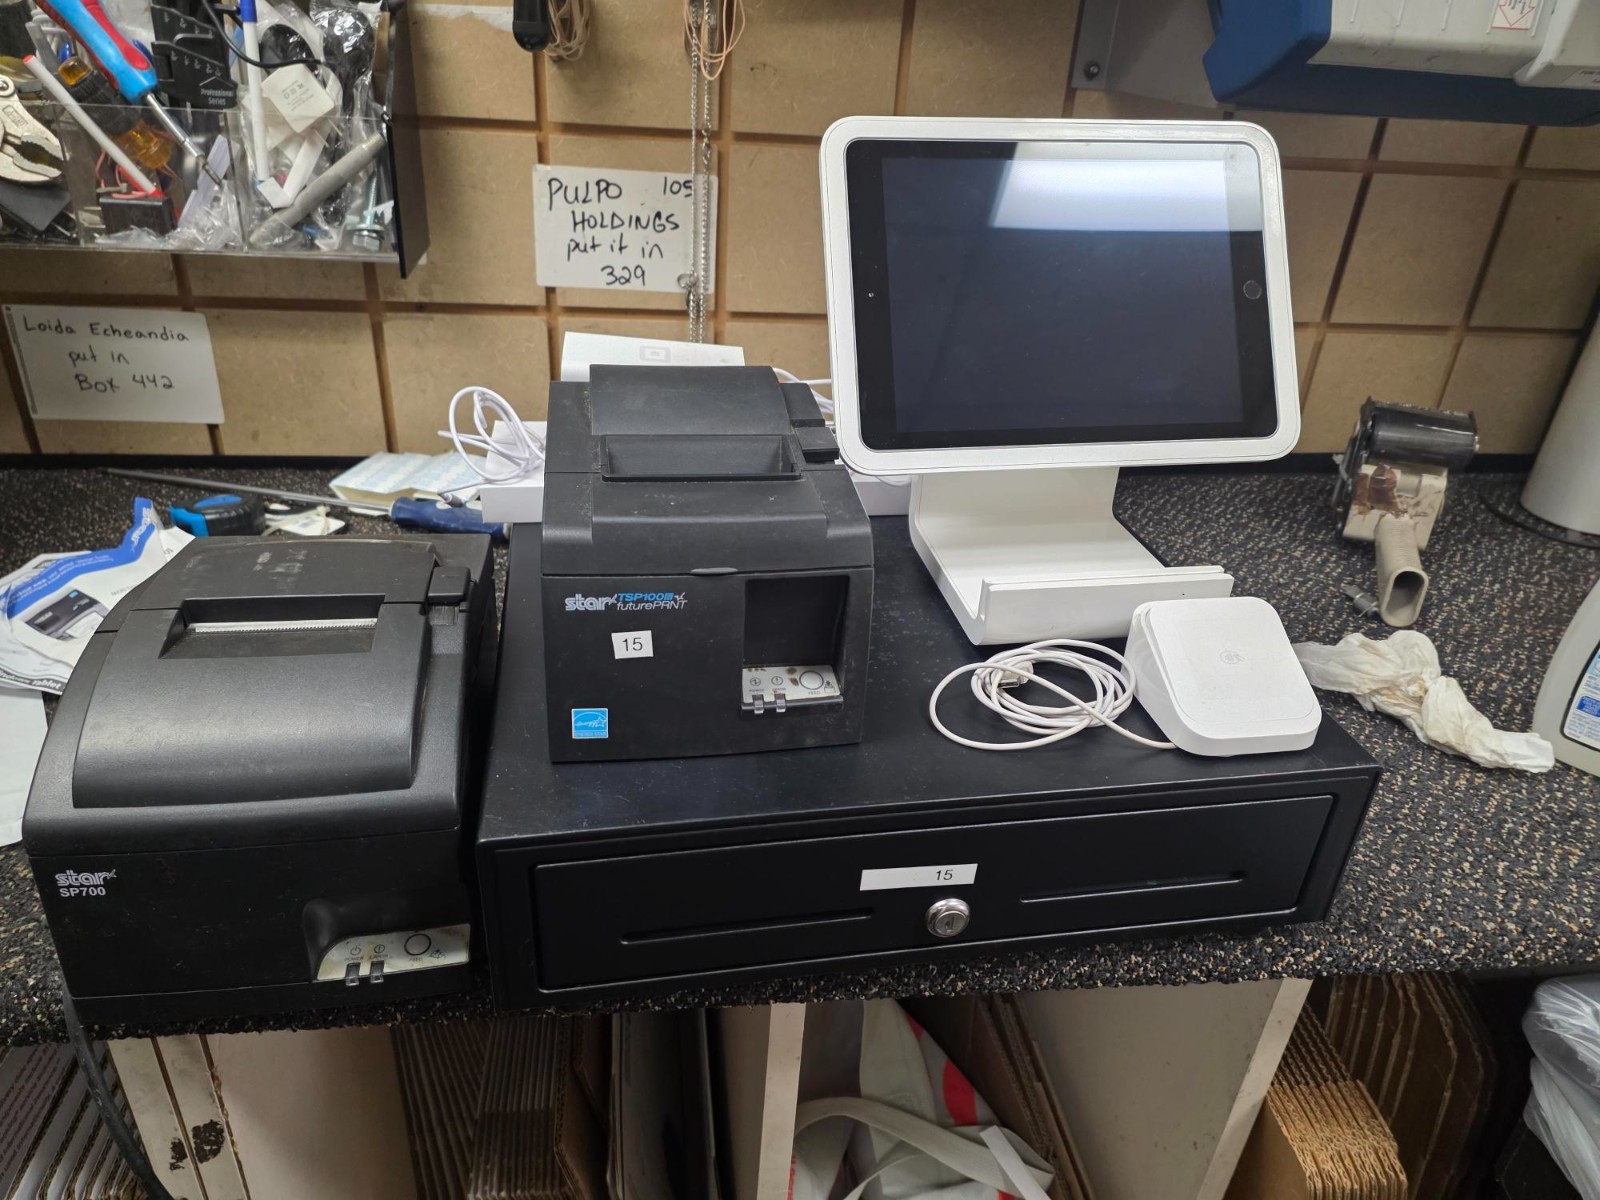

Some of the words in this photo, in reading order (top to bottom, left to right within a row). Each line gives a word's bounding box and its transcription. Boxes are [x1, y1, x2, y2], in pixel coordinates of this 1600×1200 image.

[548, 178, 622, 211] PULPO
[571, 210, 680, 233] HOLDINGS
[567, 236, 601, 262] put
[610, 232, 628, 254] it
[641, 241, 663, 259] in
[601, 265, 646, 286] 329
[23, 316, 76, 335] Loida
[89, 322, 189, 341] Echeandia
[68, 345, 97, 367] put
[111, 351, 130, 365] in
[75, 373, 120, 393] Box
[132, 374, 175, 390] 442
[564, 593, 617, 611] star
[622, 637, 643, 652] 15
[54, 868, 117, 887] star
[935, 869, 953, 881] 15
[59, 886, 106, 897] SP700
